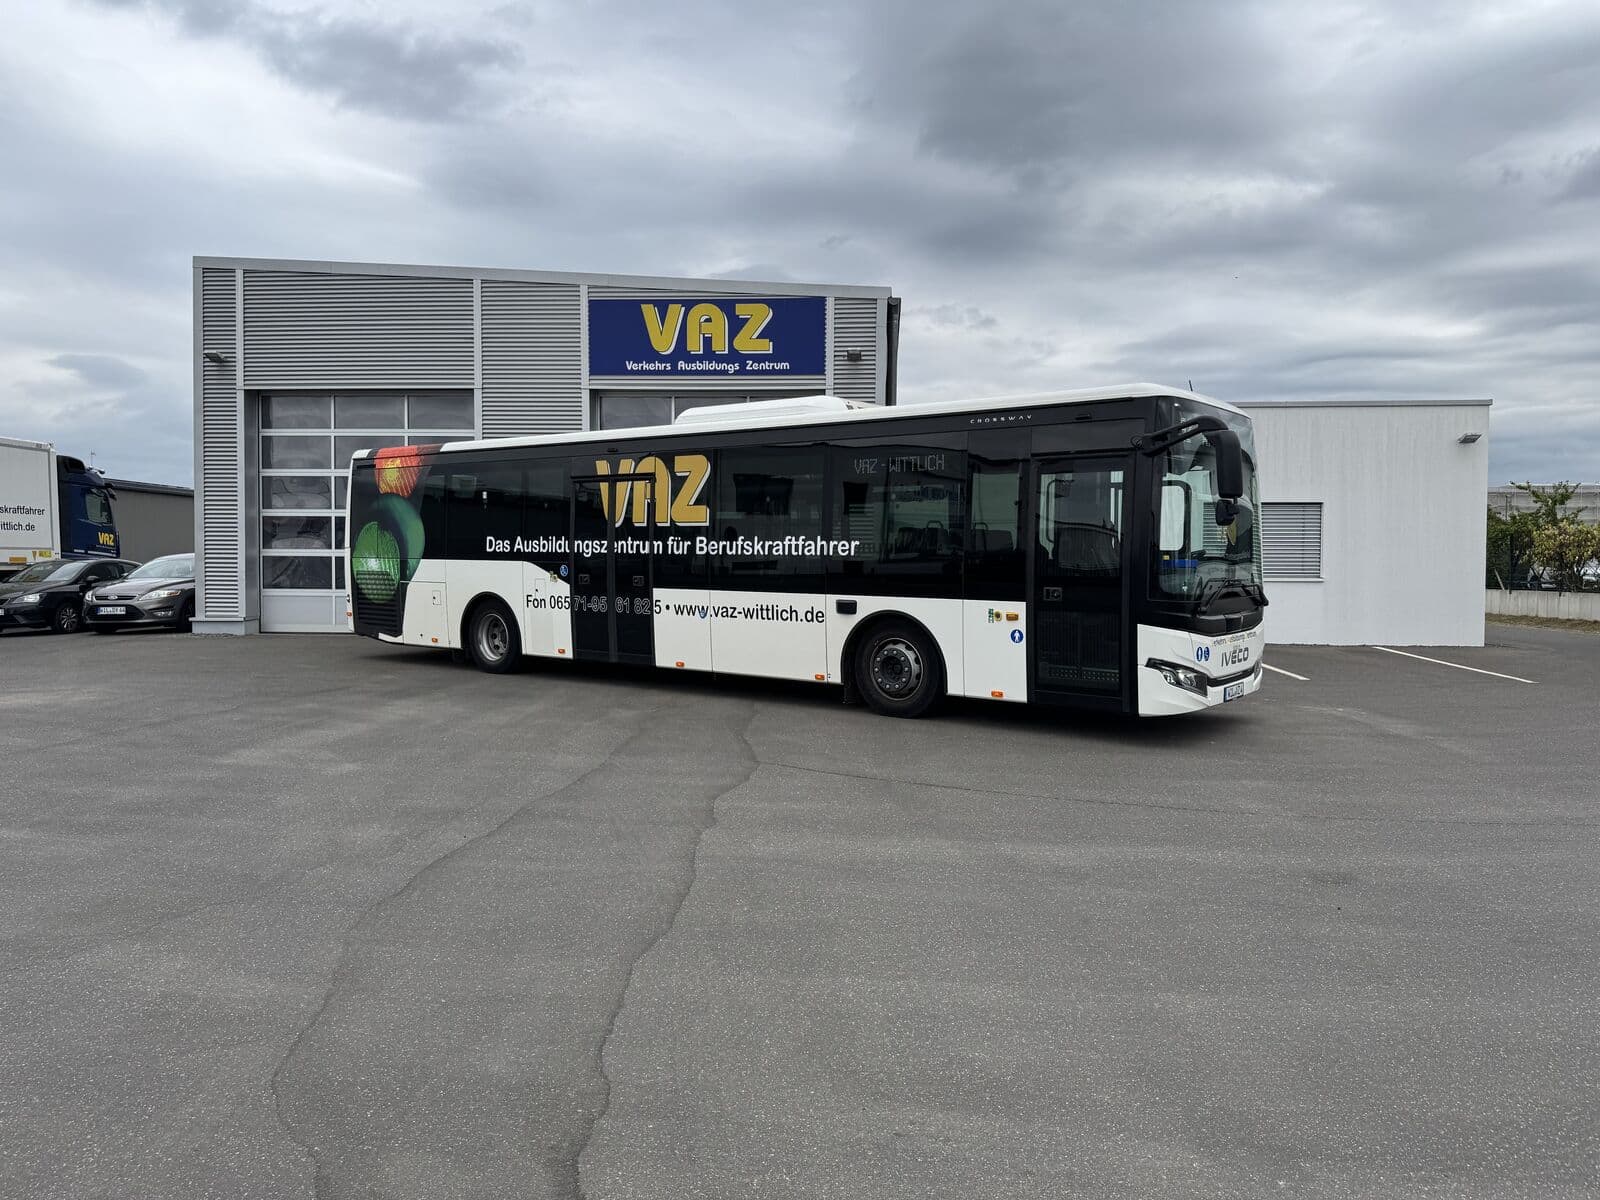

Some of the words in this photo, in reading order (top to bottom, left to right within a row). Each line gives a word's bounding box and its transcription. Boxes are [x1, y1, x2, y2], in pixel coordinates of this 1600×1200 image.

[641, 303, 774, 355] VAZ
[625, 360, 671, 371] Verkehrs
[678, 360, 740, 374] Ausbildungs
[746, 360, 790, 371] Zentrum
[595, 454, 711, 528] VAZ
[98, 532, 114, 545] VAZ
[486, 536, 510, 553] Das
[514, 535, 663, 558] Ausbildungszntrum
[666, 536, 691, 555] für
[695, 535, 860, 556] Berufskraftfahrer
[526, 594, 546, 609] Fon
[674, 602, 825, 623] www.vaz-wittlich.de
[1221, 647, 1249, 667] IVECO
